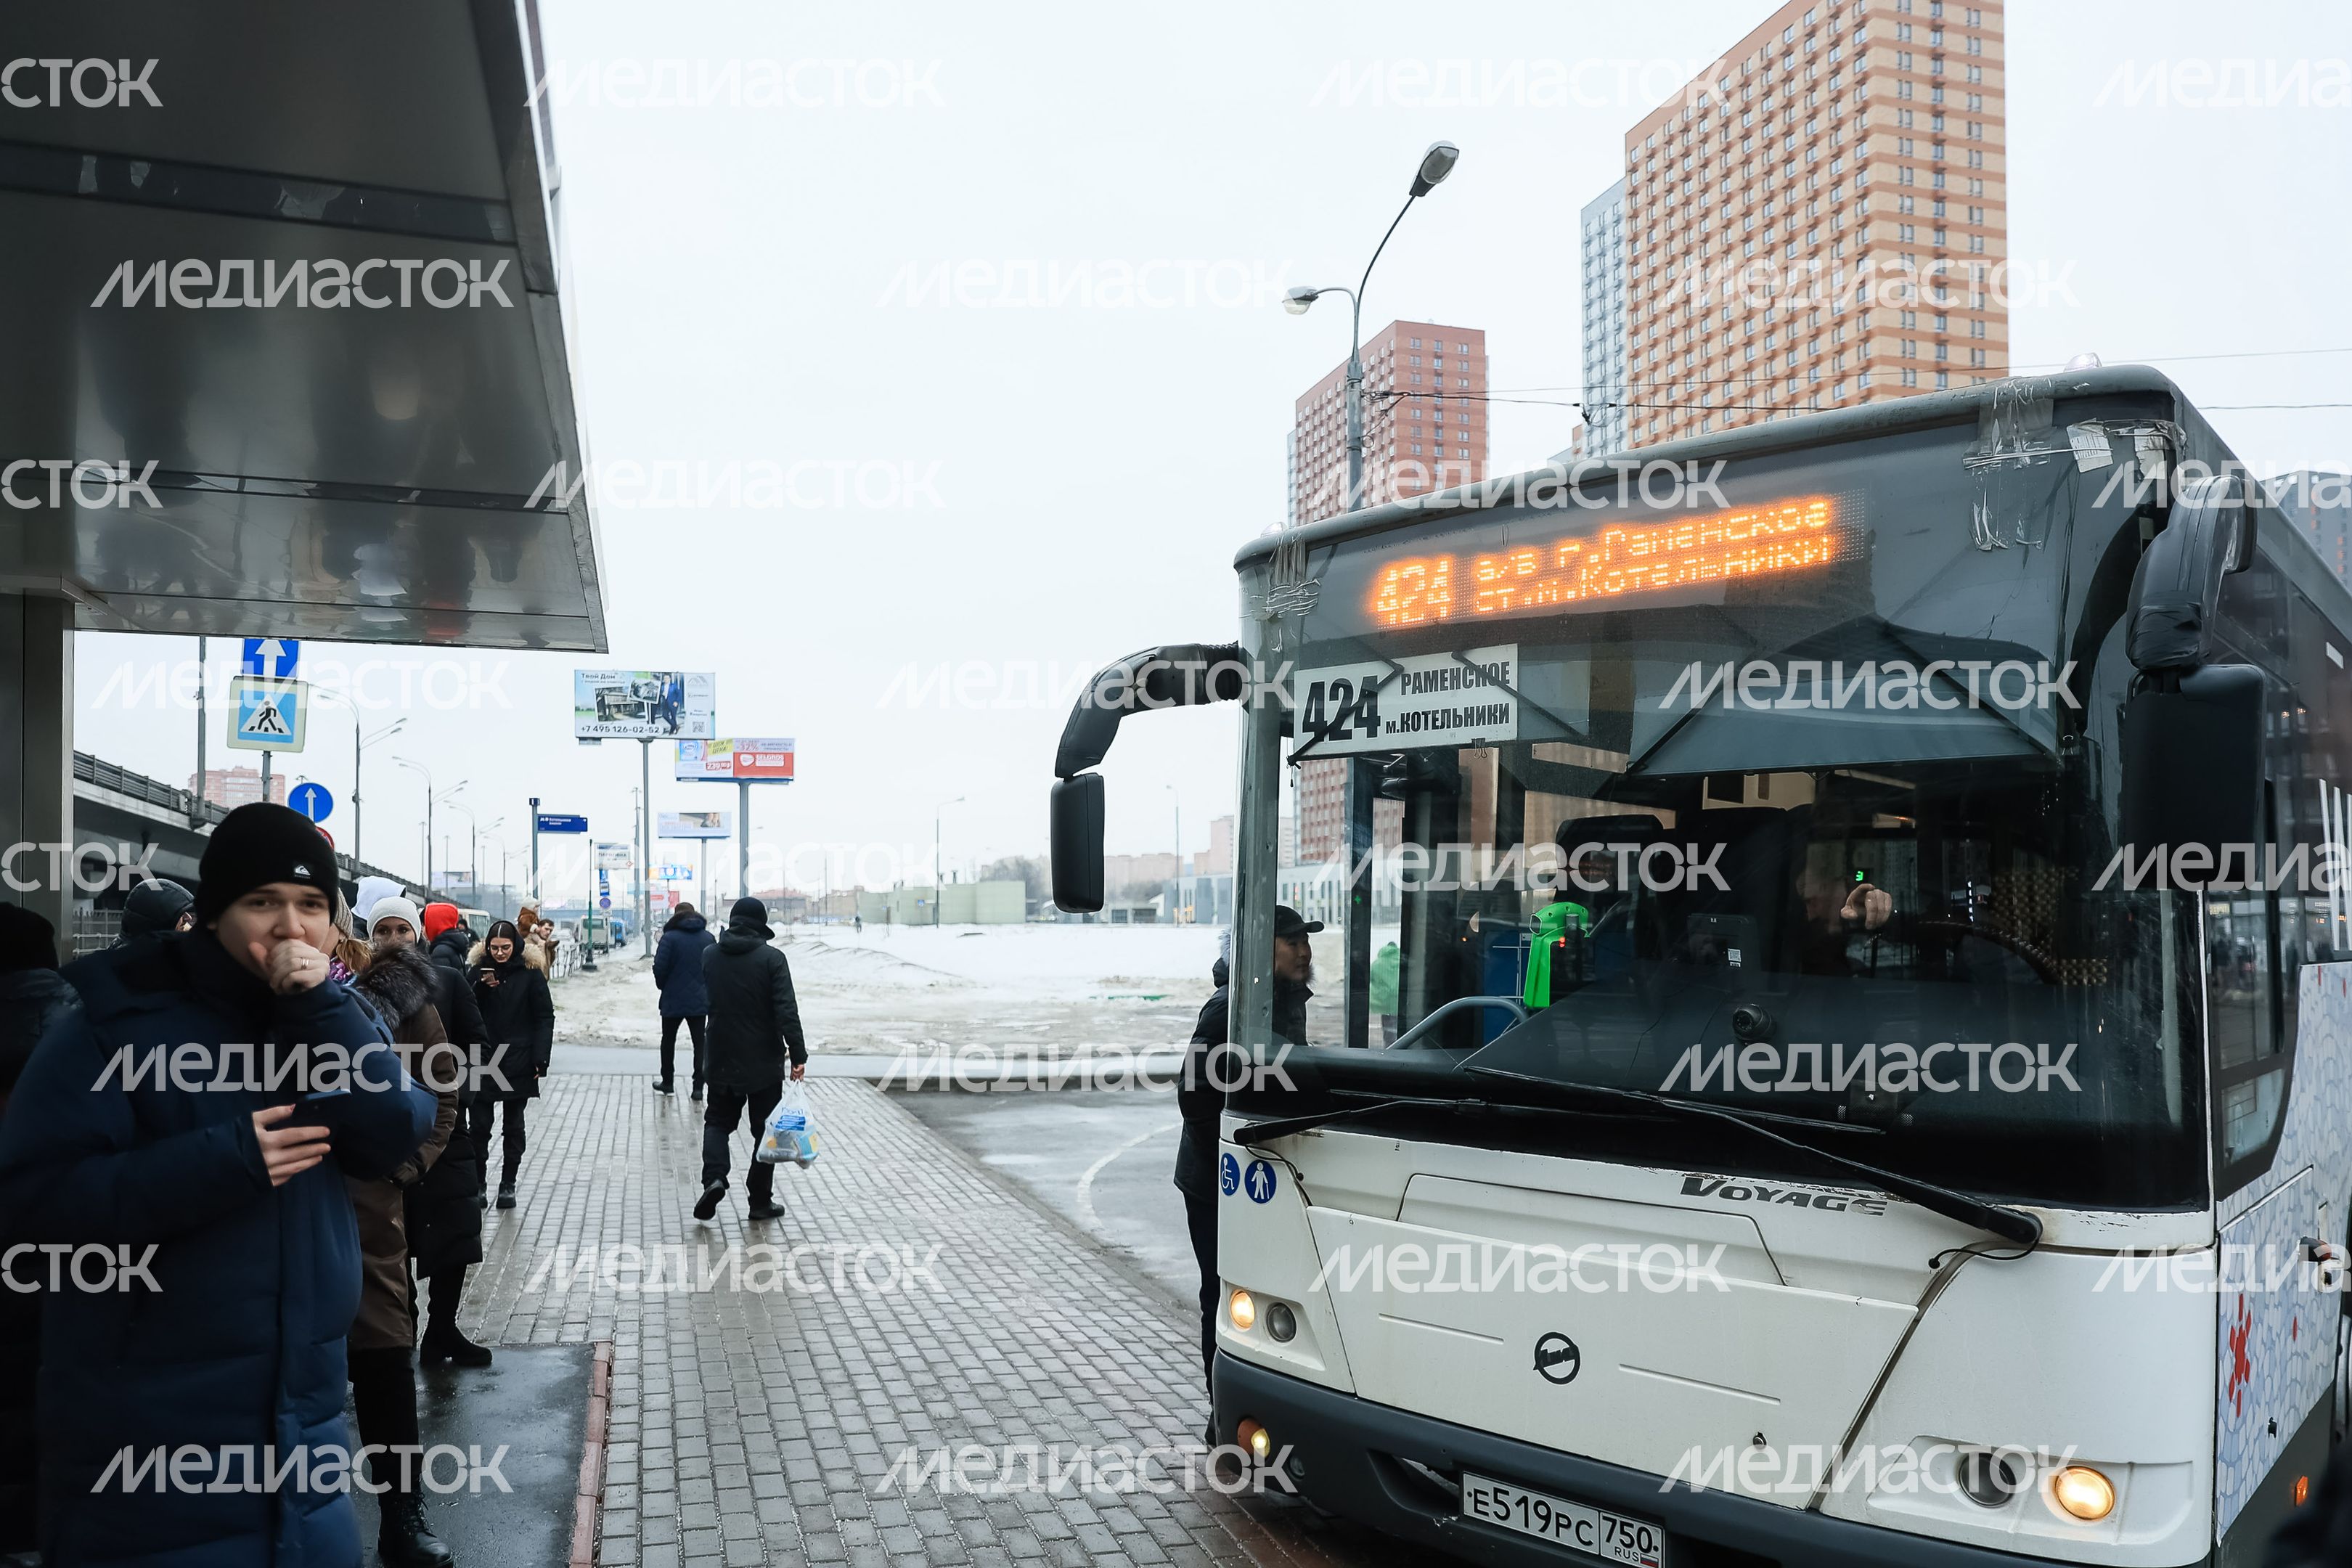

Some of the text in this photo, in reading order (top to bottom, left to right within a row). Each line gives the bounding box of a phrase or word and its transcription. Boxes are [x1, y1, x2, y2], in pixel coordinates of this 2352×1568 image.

[1377, 558, 1450, 626] 424
[1400, 661, 1510, 696] РАМЕНСКОЕ
[1302, 675, 1381, 743] 424
[1386, 703, 1510, 735] м.КОТЕЛЬНИКИ
[1681, 1176, 1887, 1216] VOYAGE
[1474, 1487, 1653, 1553] Е519РС 750
[1614, 1546, 1639, 1562] RUS
